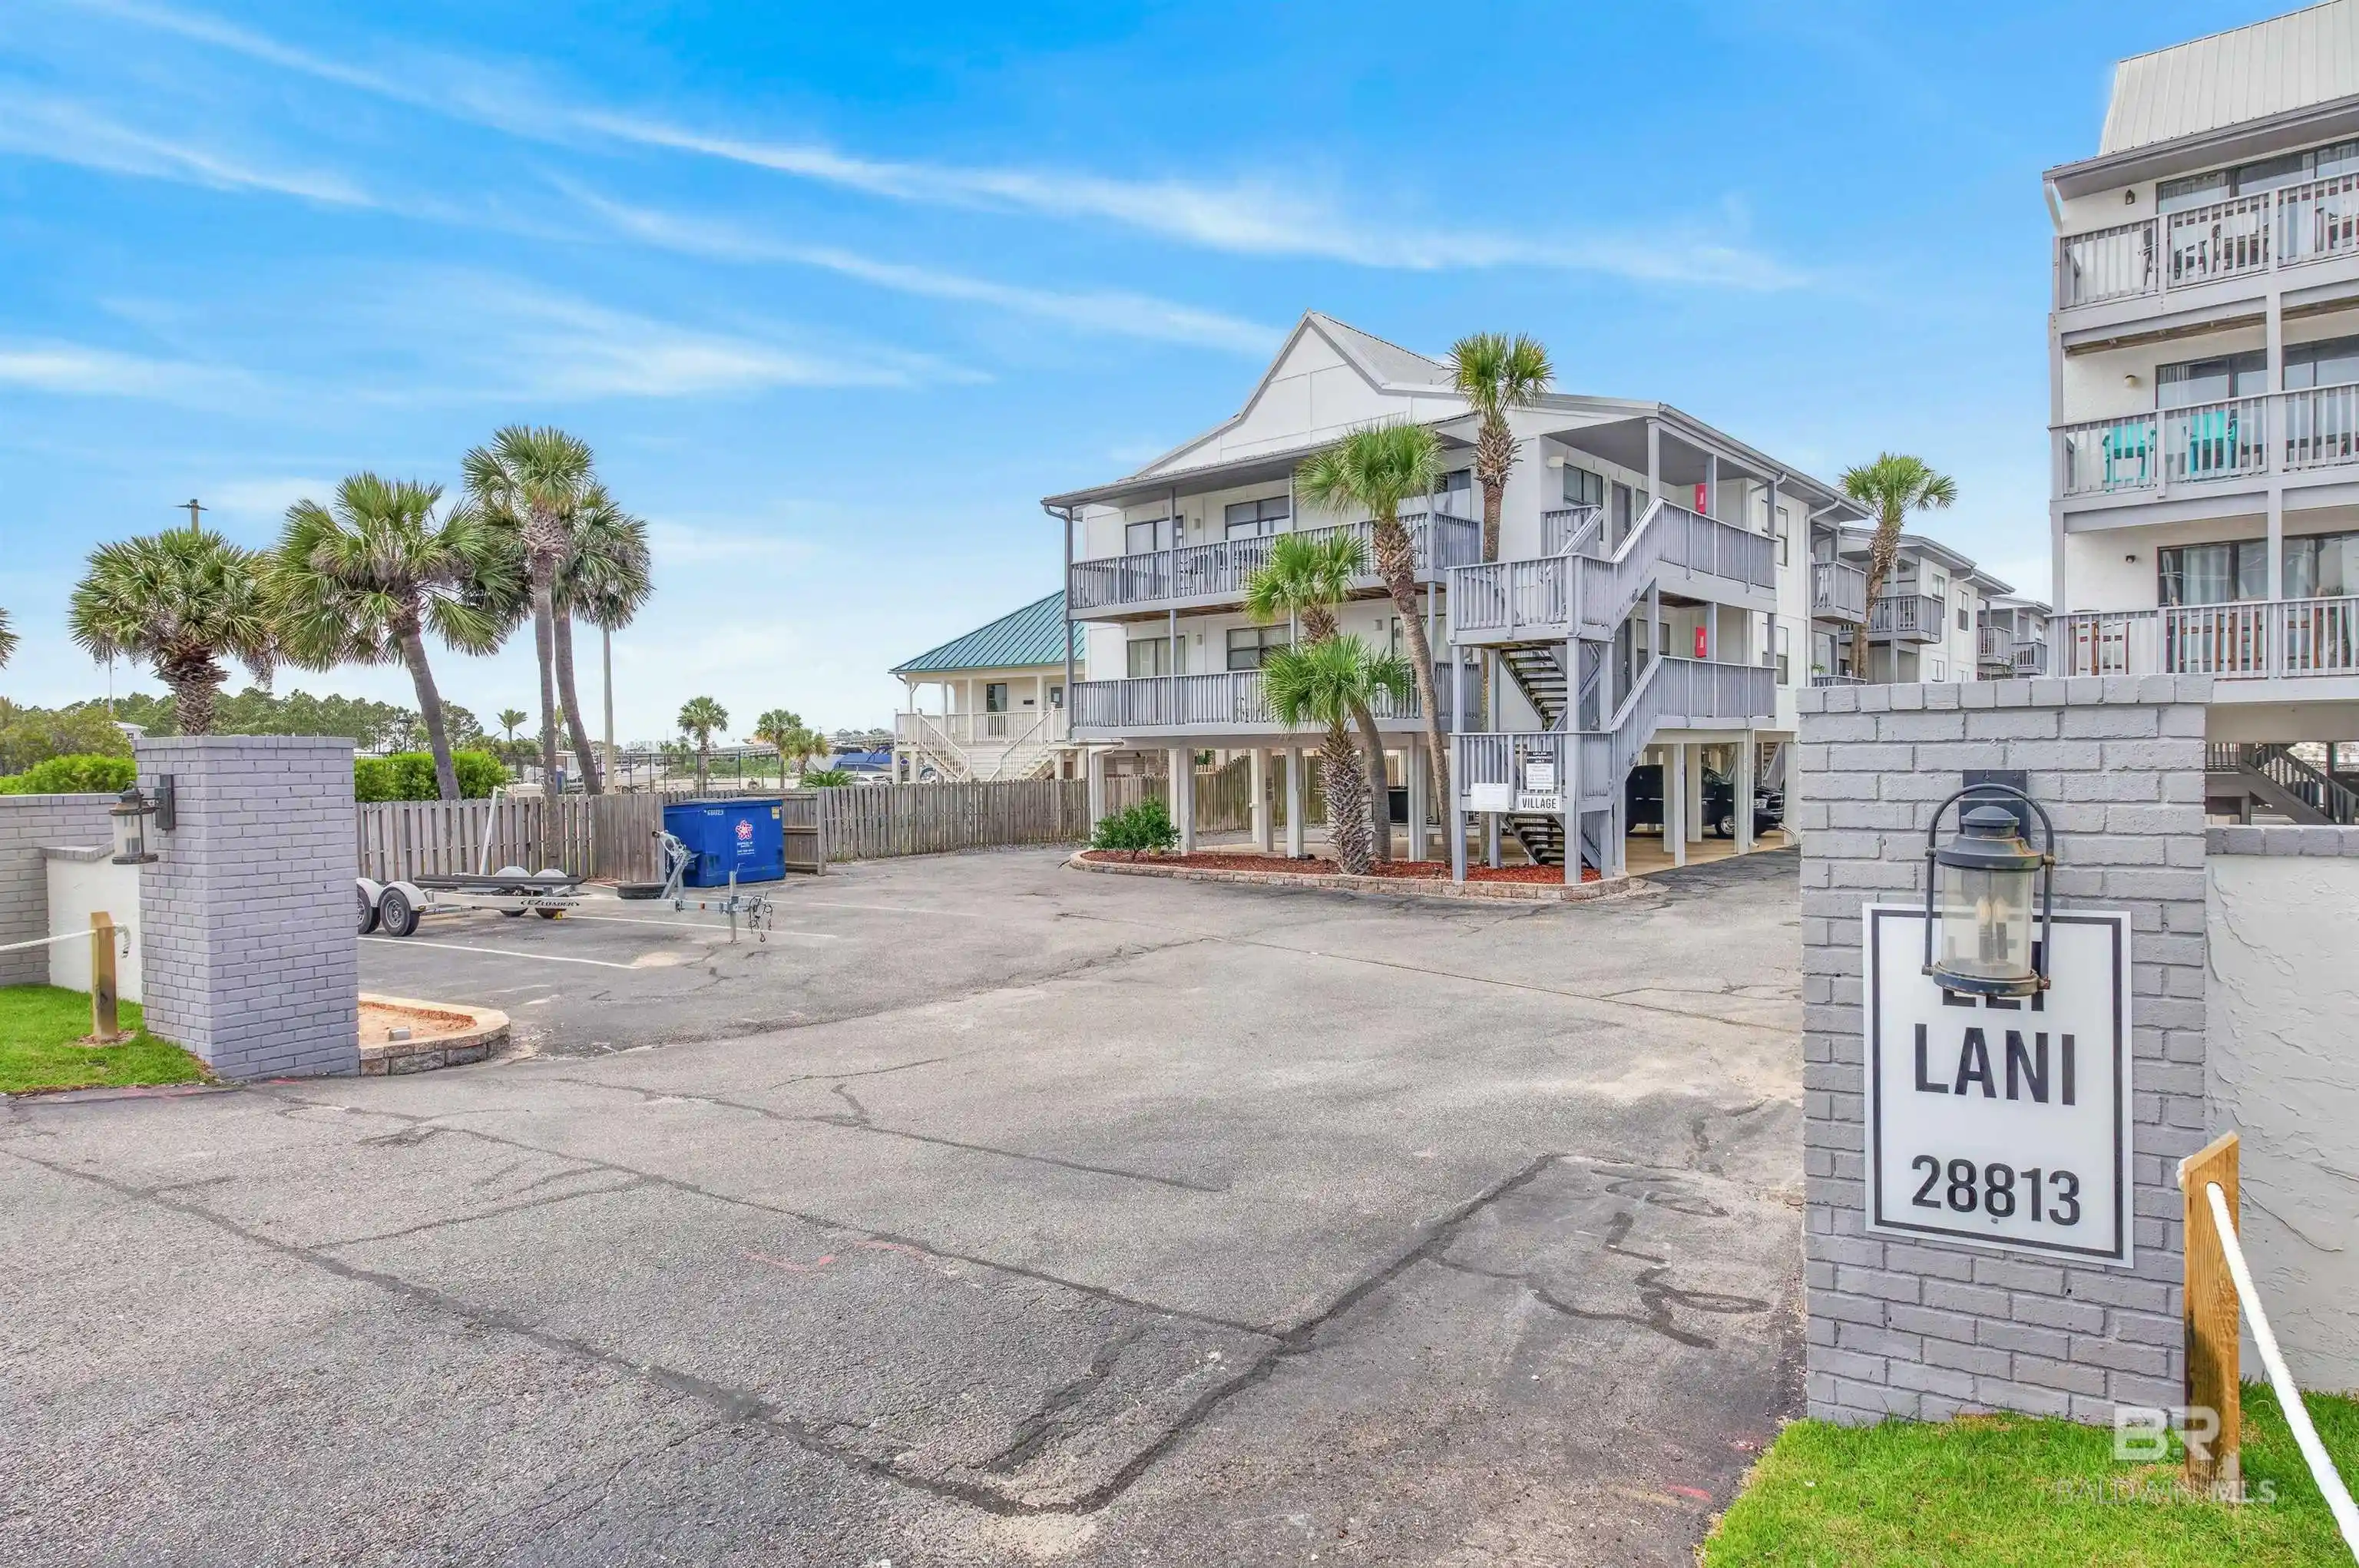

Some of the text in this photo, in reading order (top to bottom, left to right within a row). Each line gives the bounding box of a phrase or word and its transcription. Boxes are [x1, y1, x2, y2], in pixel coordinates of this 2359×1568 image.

[1522, 798, 1557, 809] VILLAGE
[1914, 1023, 2076, 1106] LANI
[1911, 1154, 2081, 1226] 28813
